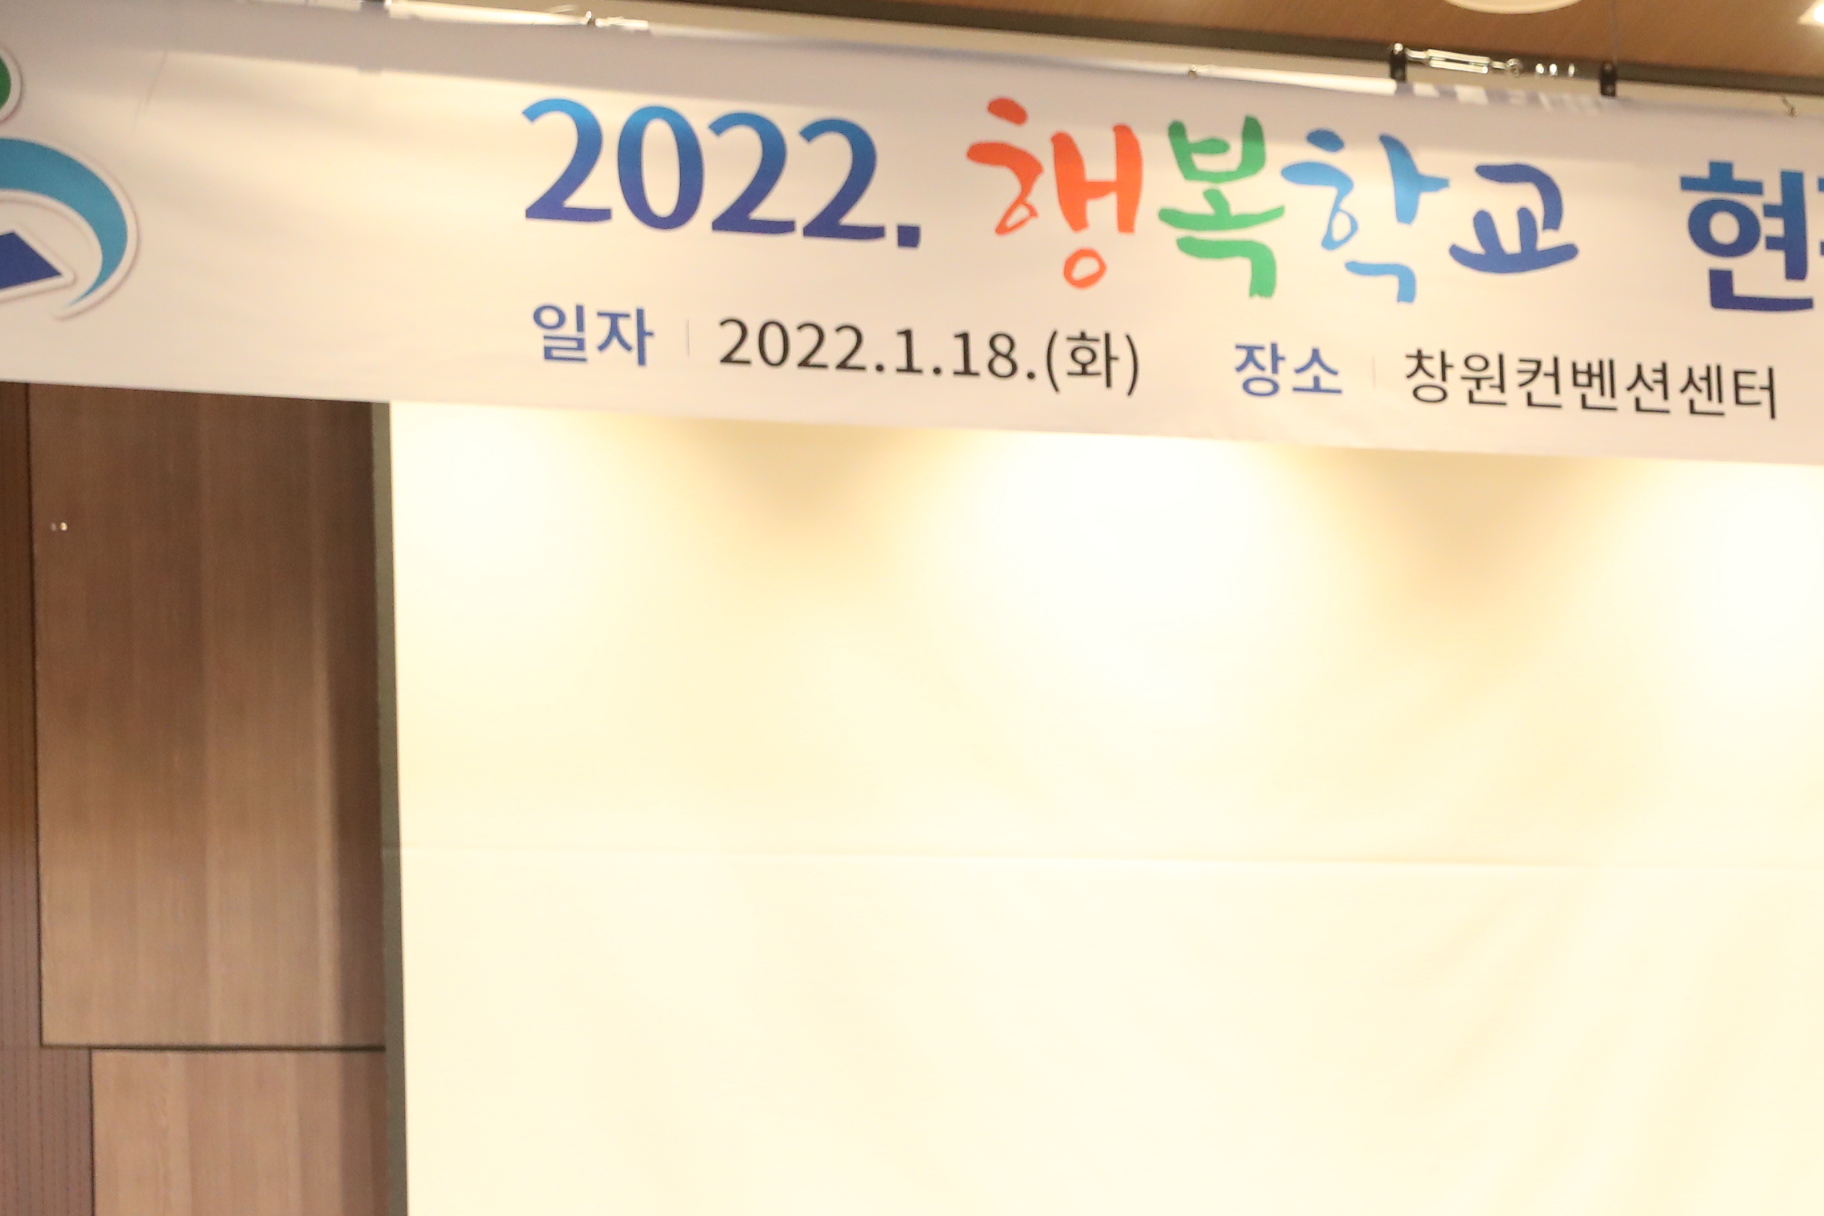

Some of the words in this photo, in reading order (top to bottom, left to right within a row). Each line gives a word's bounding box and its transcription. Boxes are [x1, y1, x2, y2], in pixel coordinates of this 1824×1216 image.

[522, 98, 921, 249] 2022.
[966, 97, 1579, 303] 행복학교
[532, 304, 655, 367] 일자
[719, 317, 1139, 396] 2022.1.18.(화)
[1235, 342, 1342, 397] 장소
[1405, 349, 1776, 420] 창원컨벤션센터
